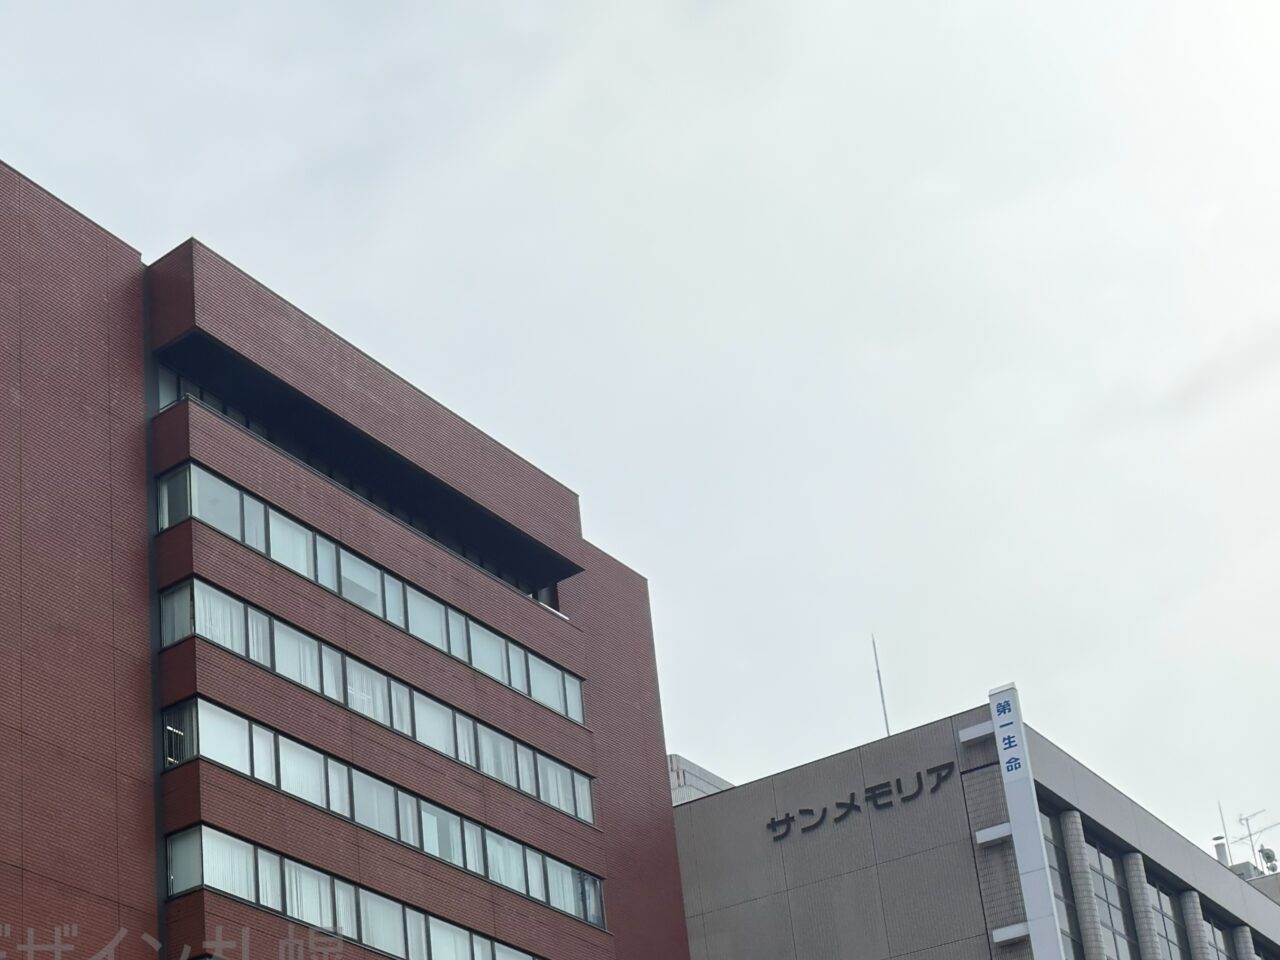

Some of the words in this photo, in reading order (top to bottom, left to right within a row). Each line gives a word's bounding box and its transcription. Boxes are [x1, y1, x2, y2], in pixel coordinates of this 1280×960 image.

[995, 699, 1022, 773] 第一生命
[766, 761, 956, 842] サンメモリア
